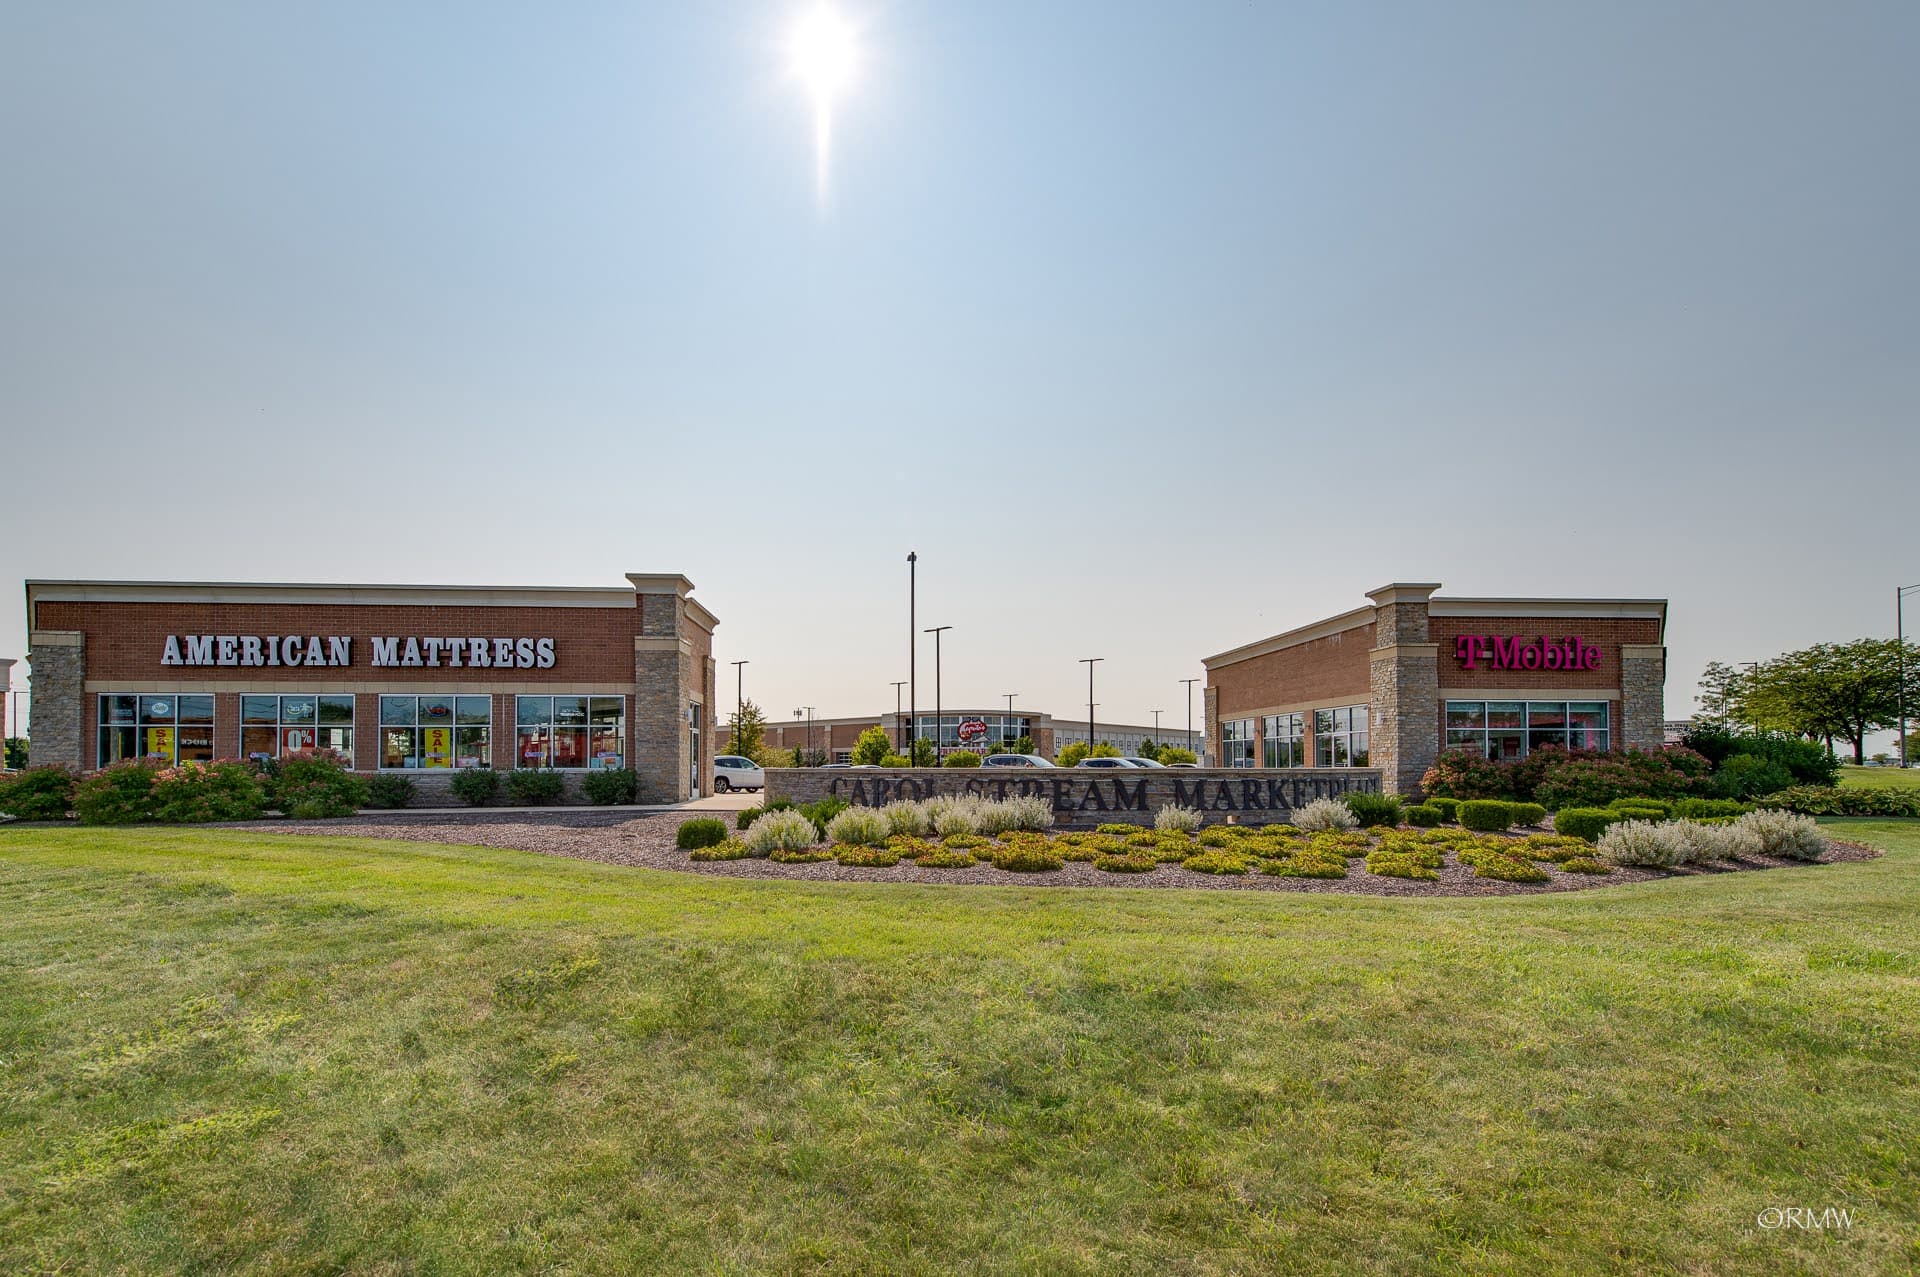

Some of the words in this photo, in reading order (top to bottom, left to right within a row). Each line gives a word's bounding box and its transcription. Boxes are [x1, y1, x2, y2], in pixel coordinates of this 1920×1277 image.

[160, 634, 352, 667] AMERICAN
[370, 636, 557, 669] MATTRESS
[287, 729, 312, 753] 0%
